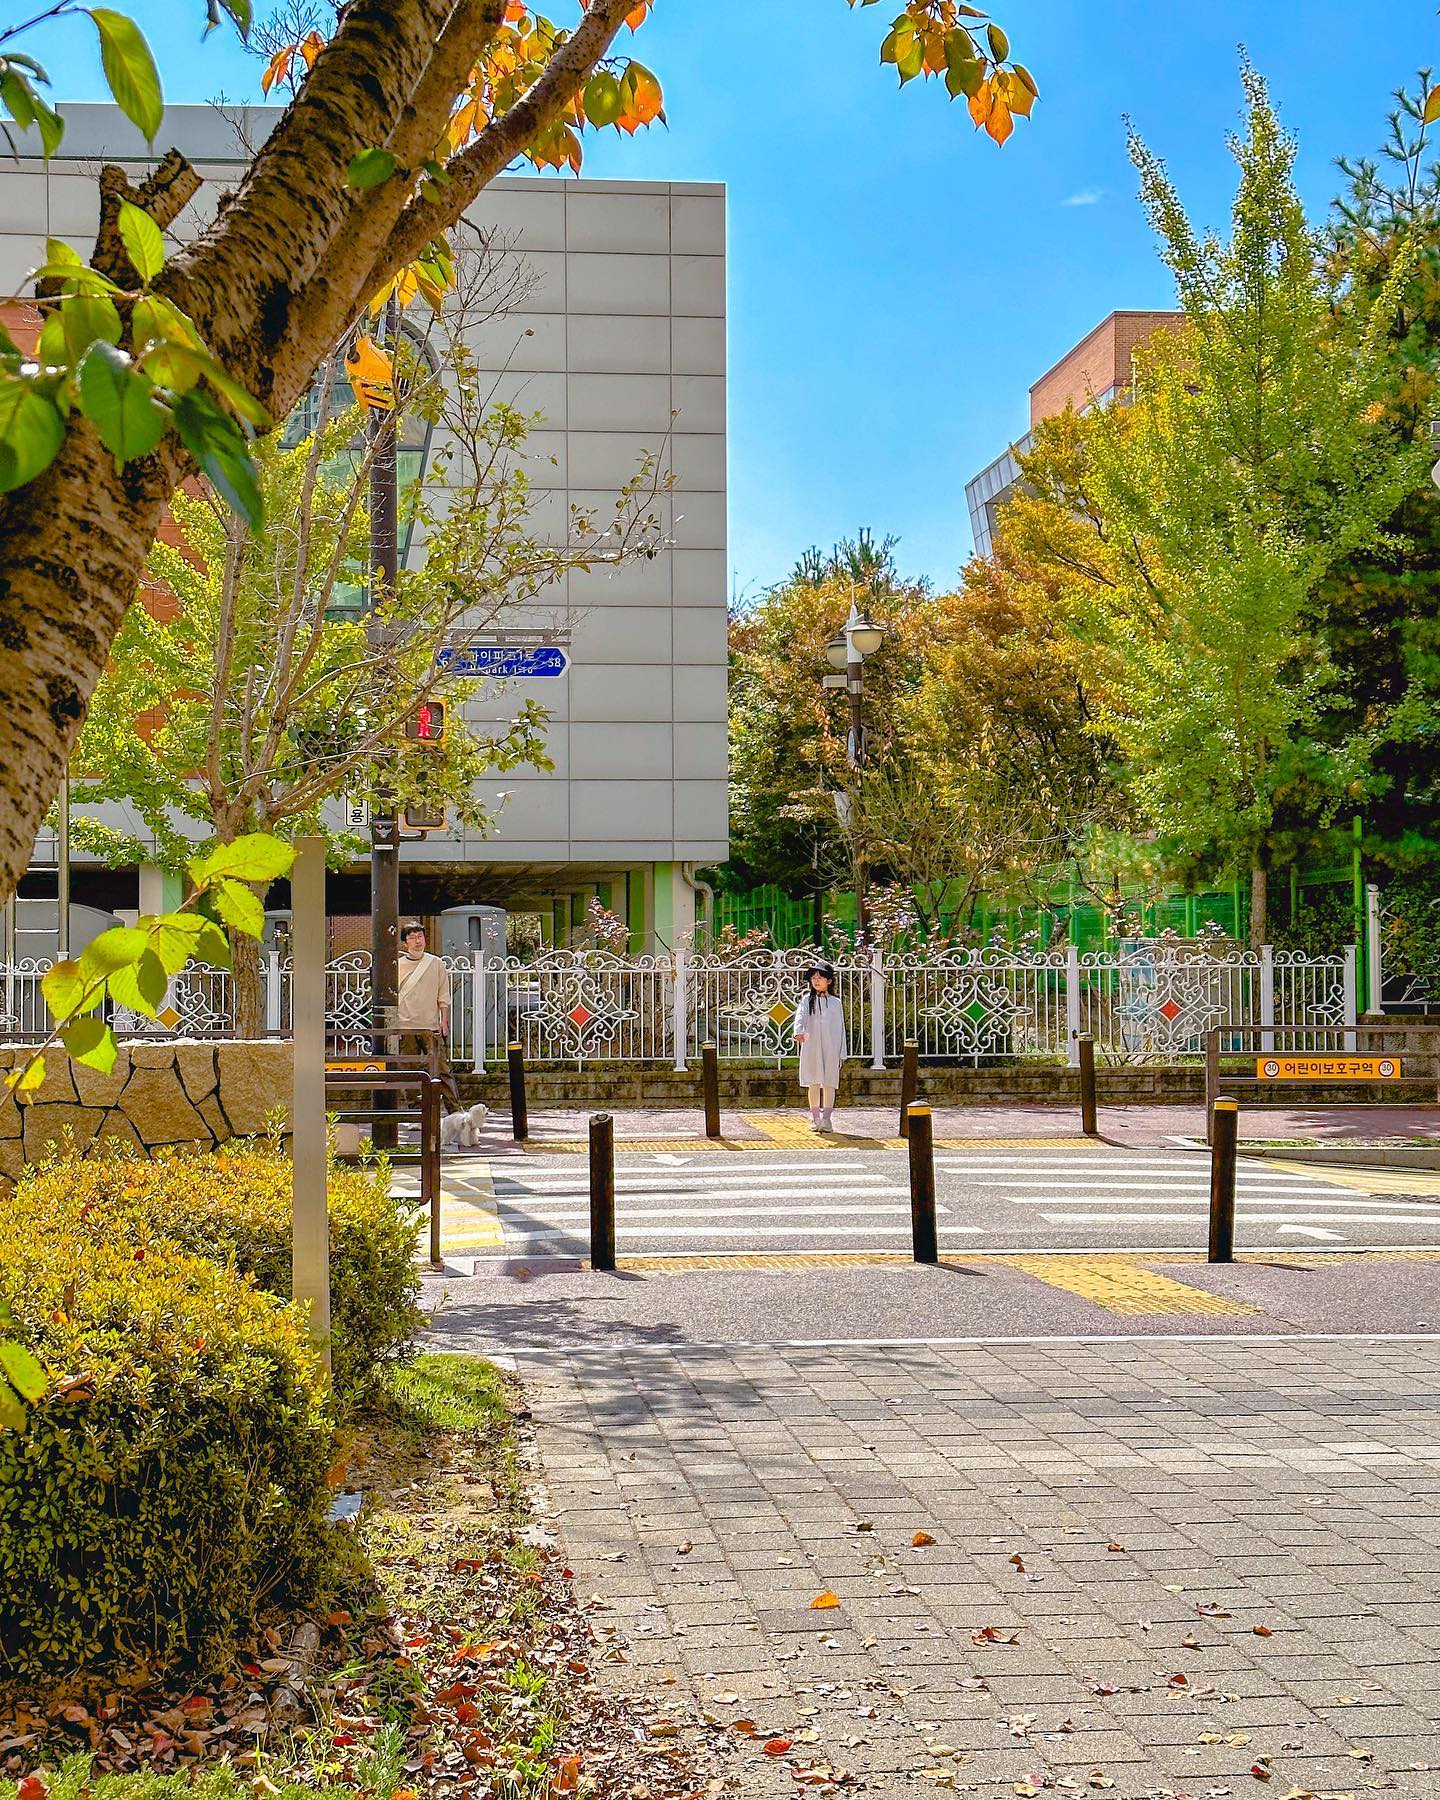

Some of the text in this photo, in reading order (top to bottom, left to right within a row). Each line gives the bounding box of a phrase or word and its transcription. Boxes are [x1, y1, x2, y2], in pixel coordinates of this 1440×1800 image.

[1266, 1063, 1277, 1072] 30
[1284, 1062, 1374, 1075] 어린이보호구역
[1381, 1063, 1392, 1072] 30
